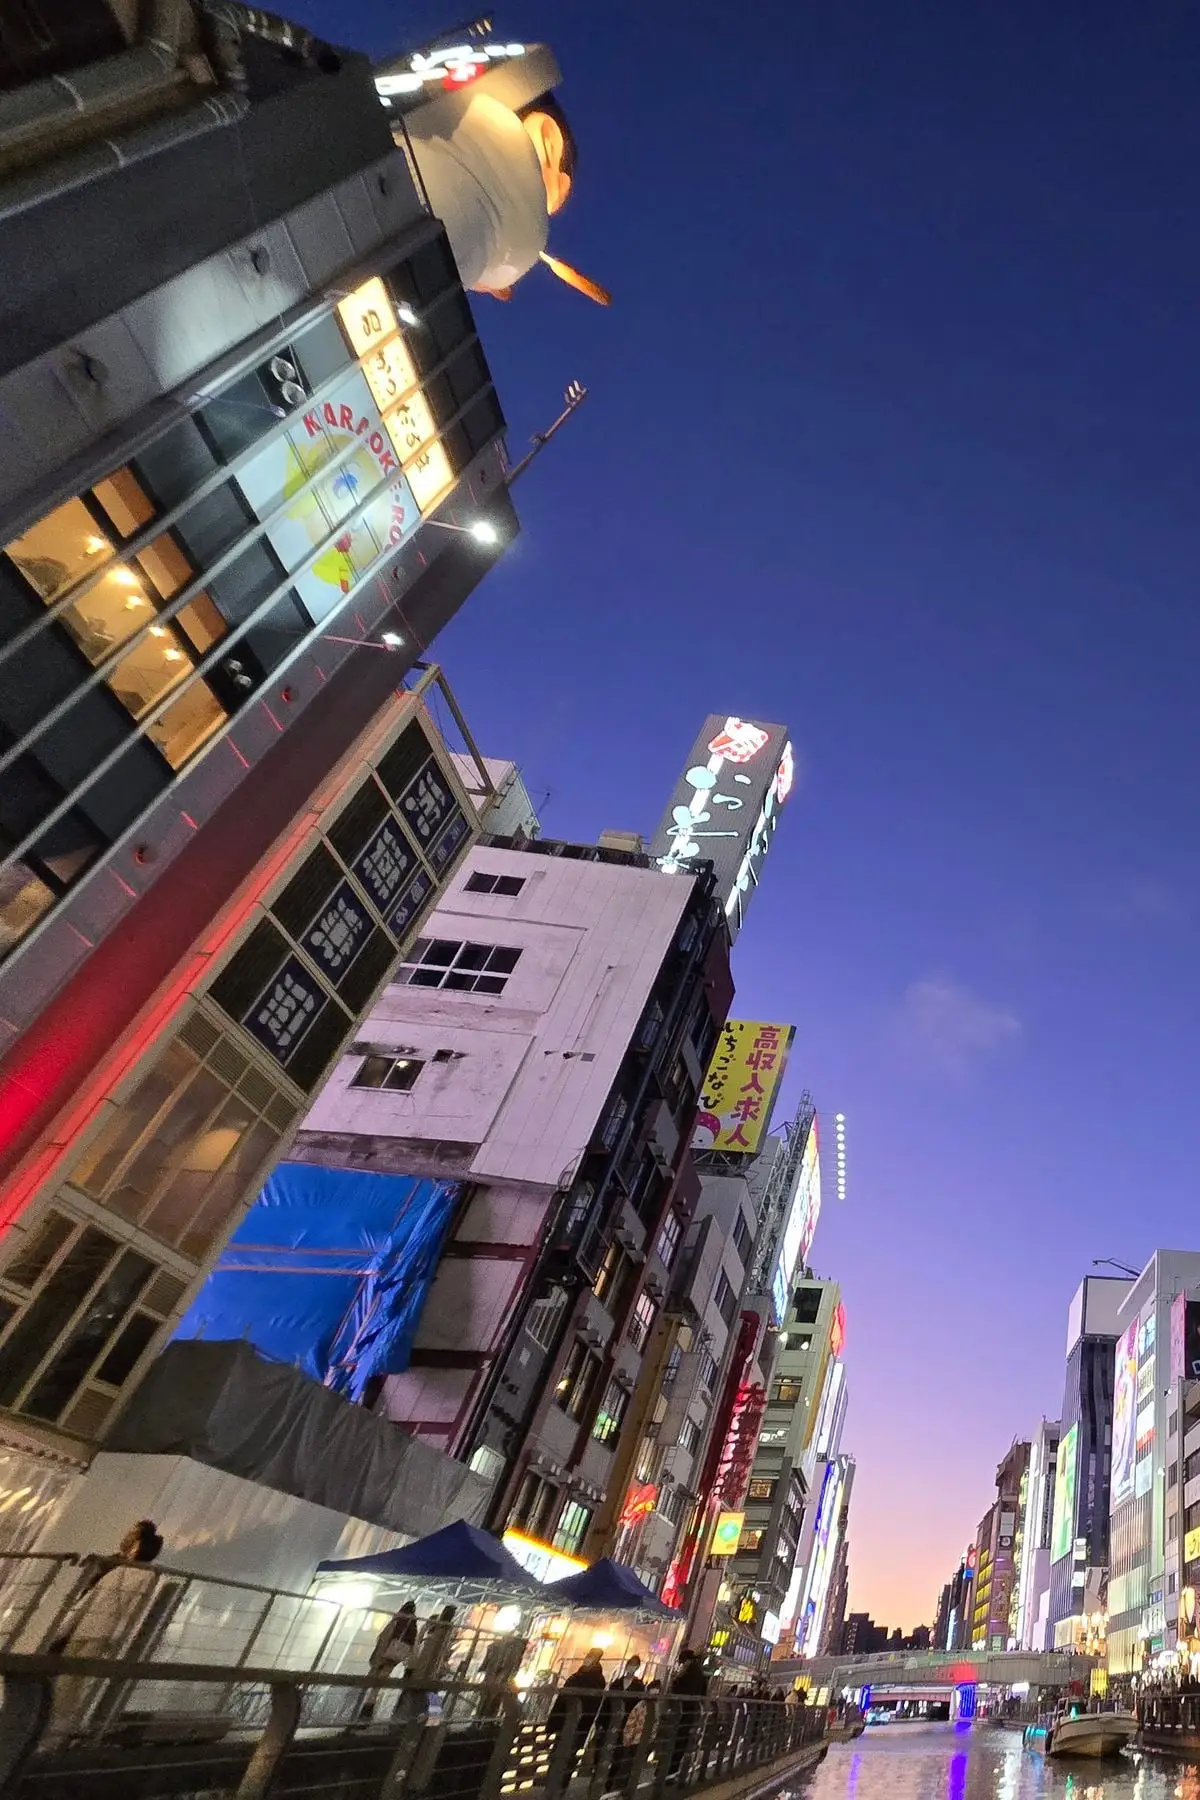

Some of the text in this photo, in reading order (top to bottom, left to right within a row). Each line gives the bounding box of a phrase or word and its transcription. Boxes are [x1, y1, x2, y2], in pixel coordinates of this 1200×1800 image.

[699, 1021, 746, 1111] いちごなび
[724, 1026, 781, 1149] 高収入求人
